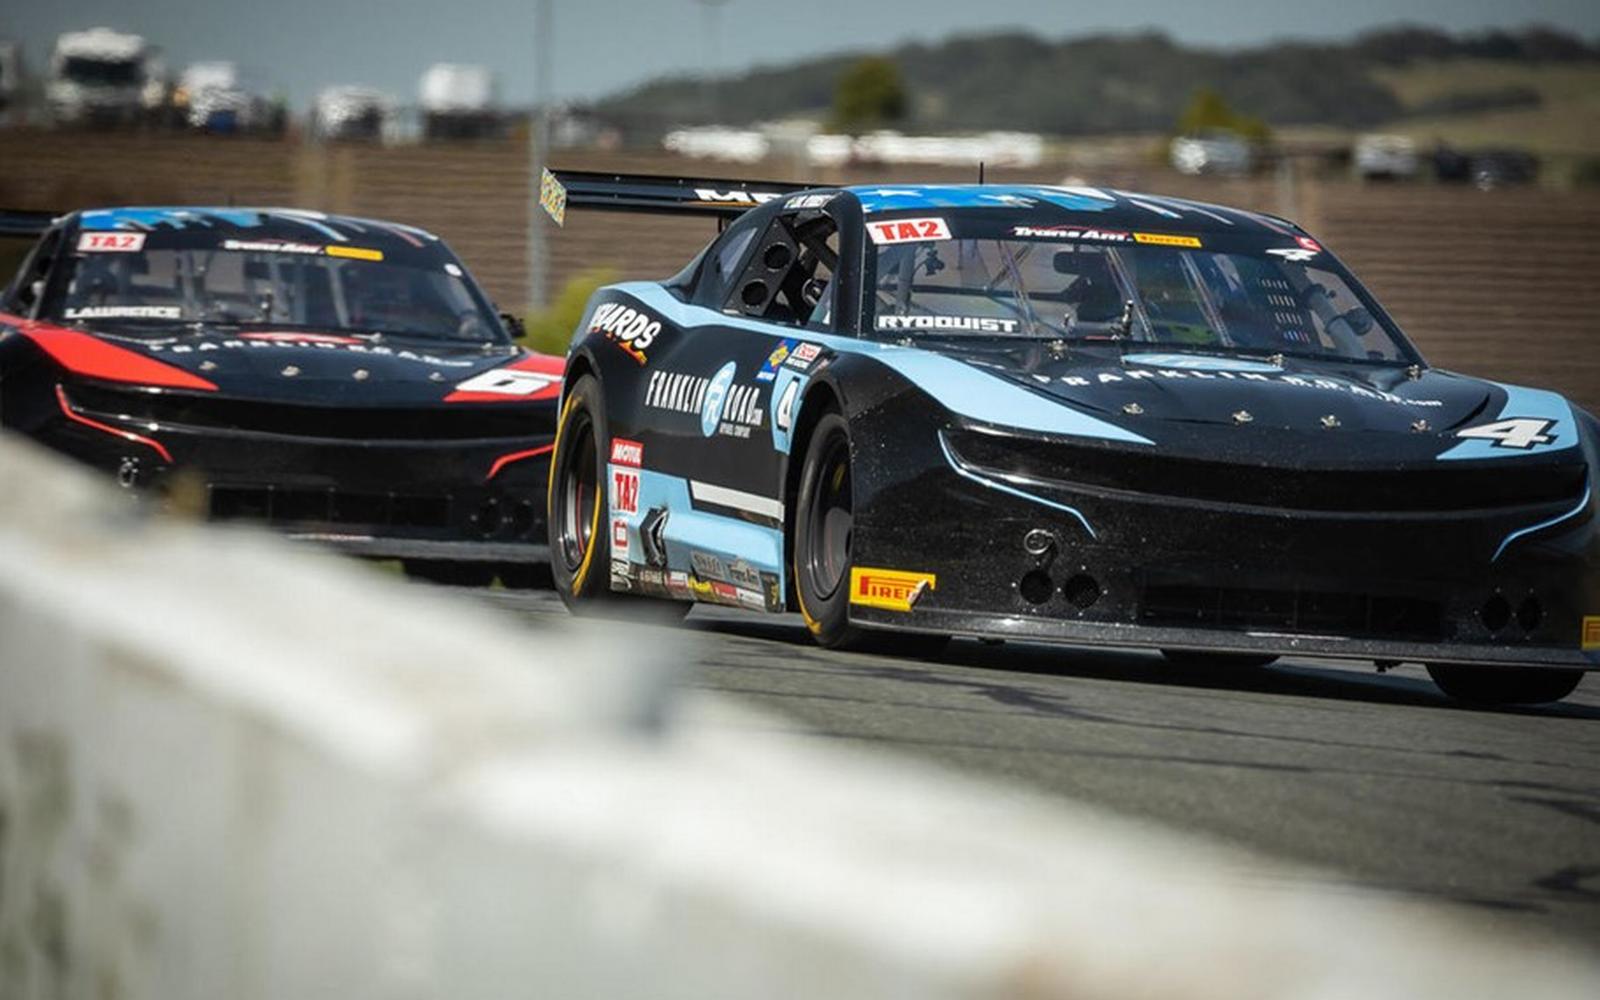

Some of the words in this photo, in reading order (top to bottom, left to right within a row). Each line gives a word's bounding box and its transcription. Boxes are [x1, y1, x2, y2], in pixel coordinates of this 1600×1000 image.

[89, 235, 137, 248] TA2
[875, 220, 943, 241] TA2
[64, 305, 182, 319] LAWRENCE
[644, 370, 711, 415] FRANKLIN
[777, 377, 801, 432] 4
[1456, 417, 1557, 450] 4
[614, 472, 638, 513] TA2
